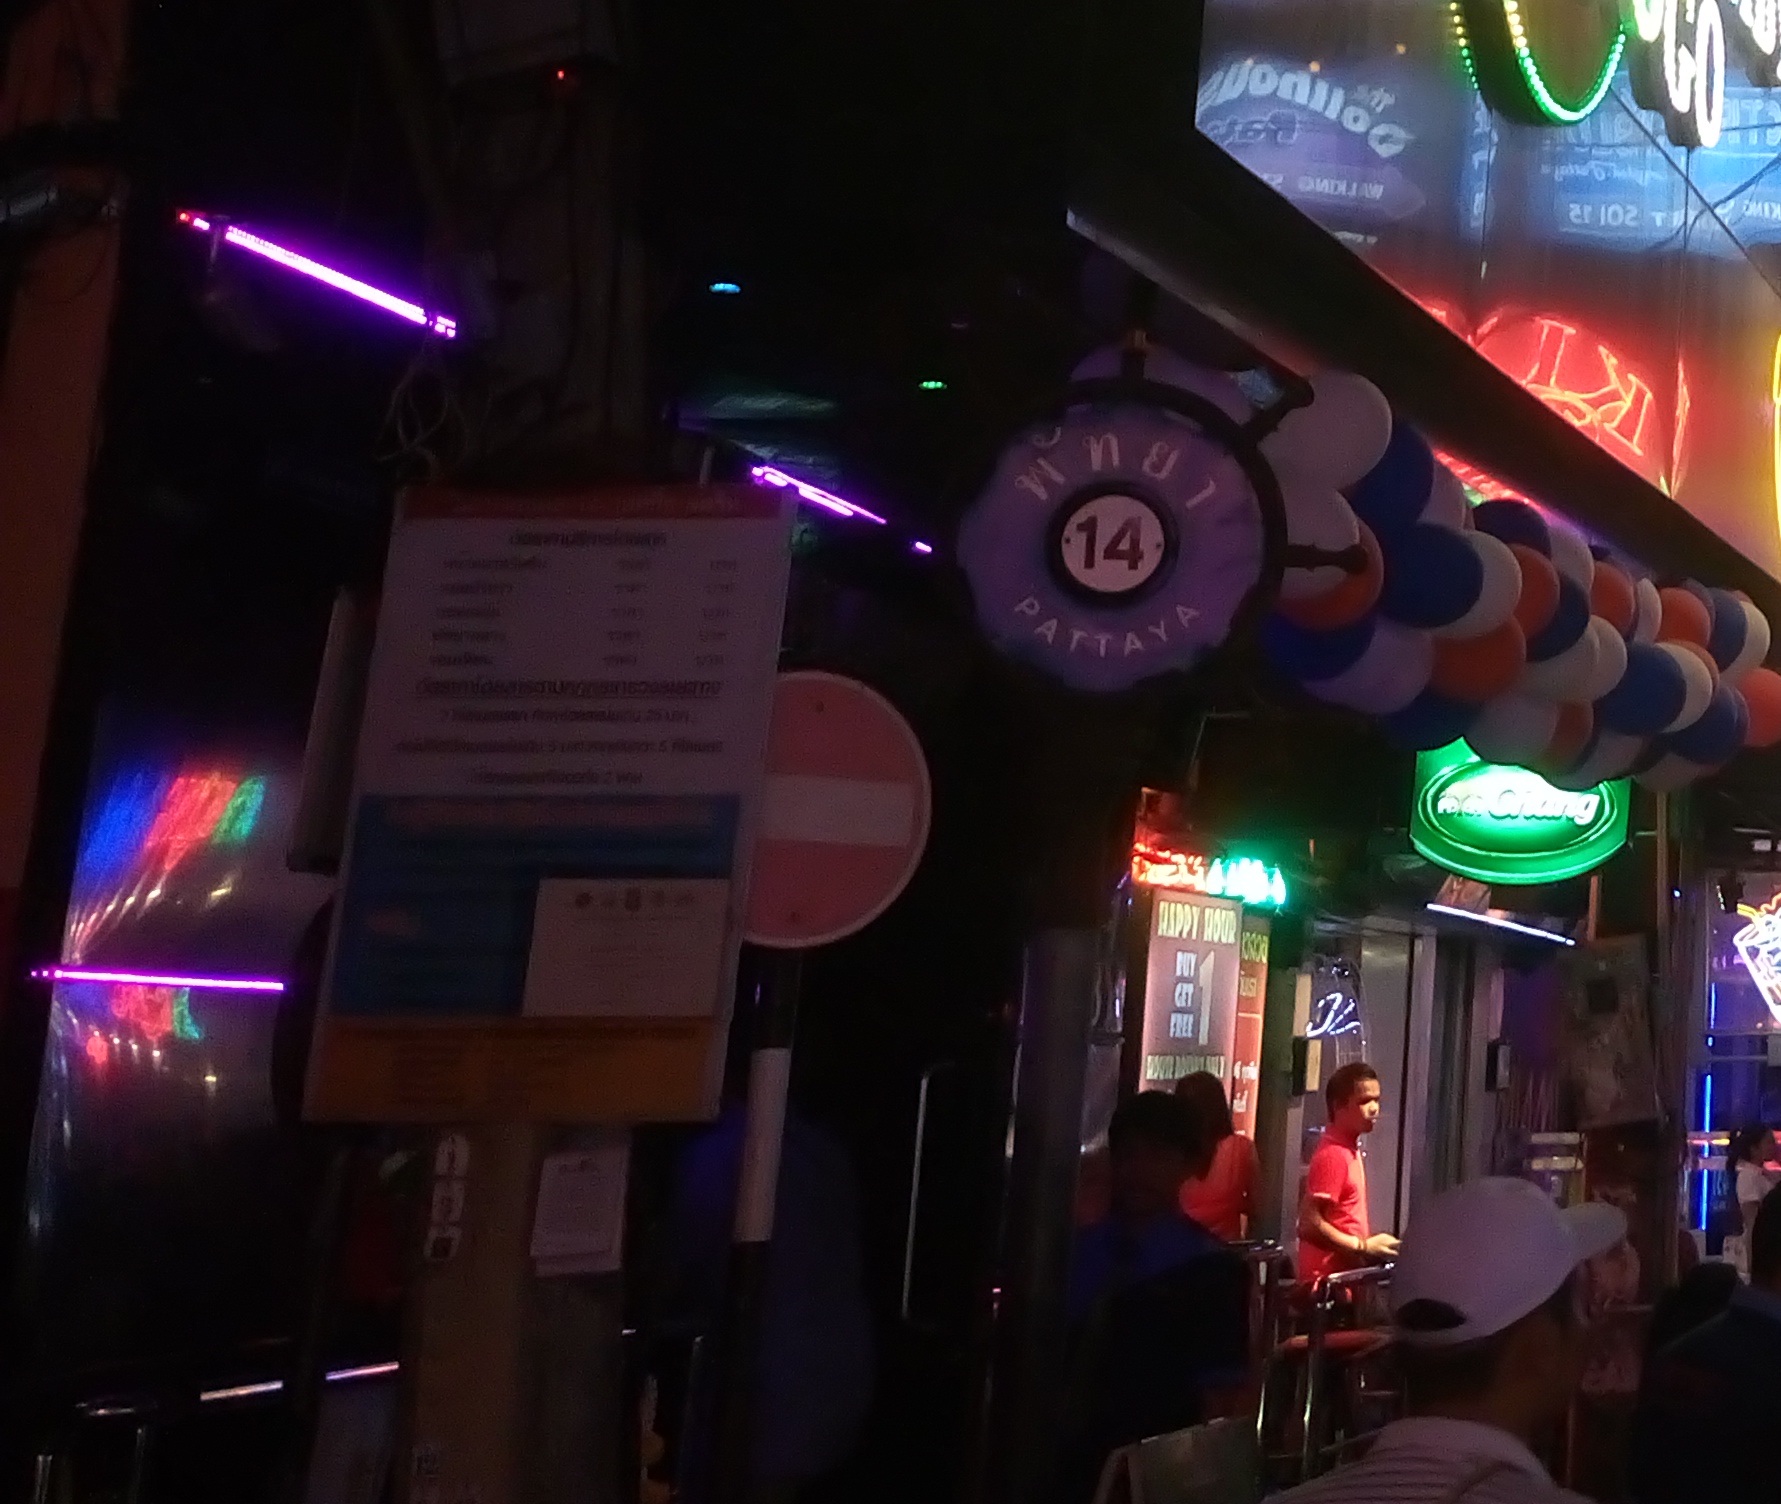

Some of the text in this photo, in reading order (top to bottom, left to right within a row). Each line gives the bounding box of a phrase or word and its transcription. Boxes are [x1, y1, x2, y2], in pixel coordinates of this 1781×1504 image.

[1075, 515, 1144, 572] 14
[1014, 594, 1201, 659] PATTAYA
[1158, 900, 1237, 945] HAPPY HOUR
[1175, 951, 1197, 978] BUY
[1174, 983, 1194, 1009] GET
[1170, 1012, 1194, 1039] FREE
